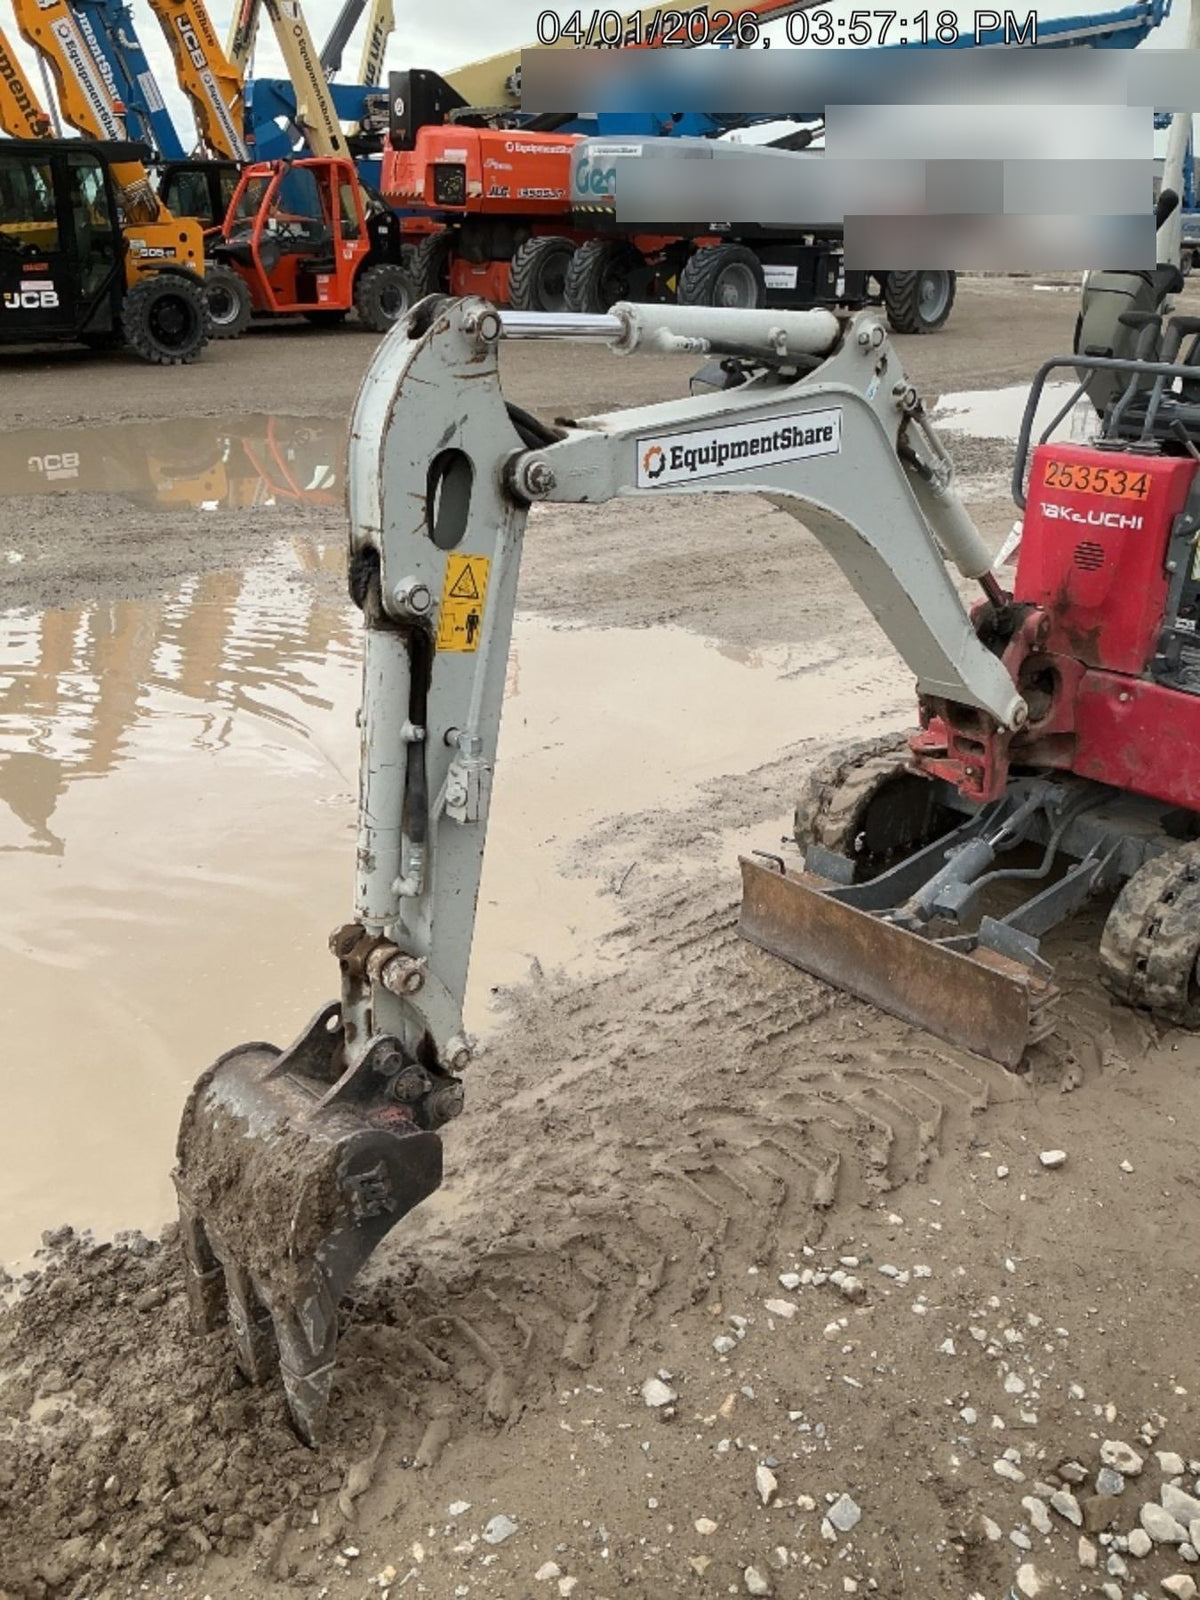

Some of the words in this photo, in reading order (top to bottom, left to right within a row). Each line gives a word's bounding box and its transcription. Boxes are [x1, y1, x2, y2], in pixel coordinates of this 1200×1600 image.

[176, 16, 208, 69] JCB
[370, 24, 383, 58] LIFT
[4, 291, 60, 309] JCB
[669, 424, 833, 472] EquipmentShare
[1044, 461, 1148, 498] 253534
